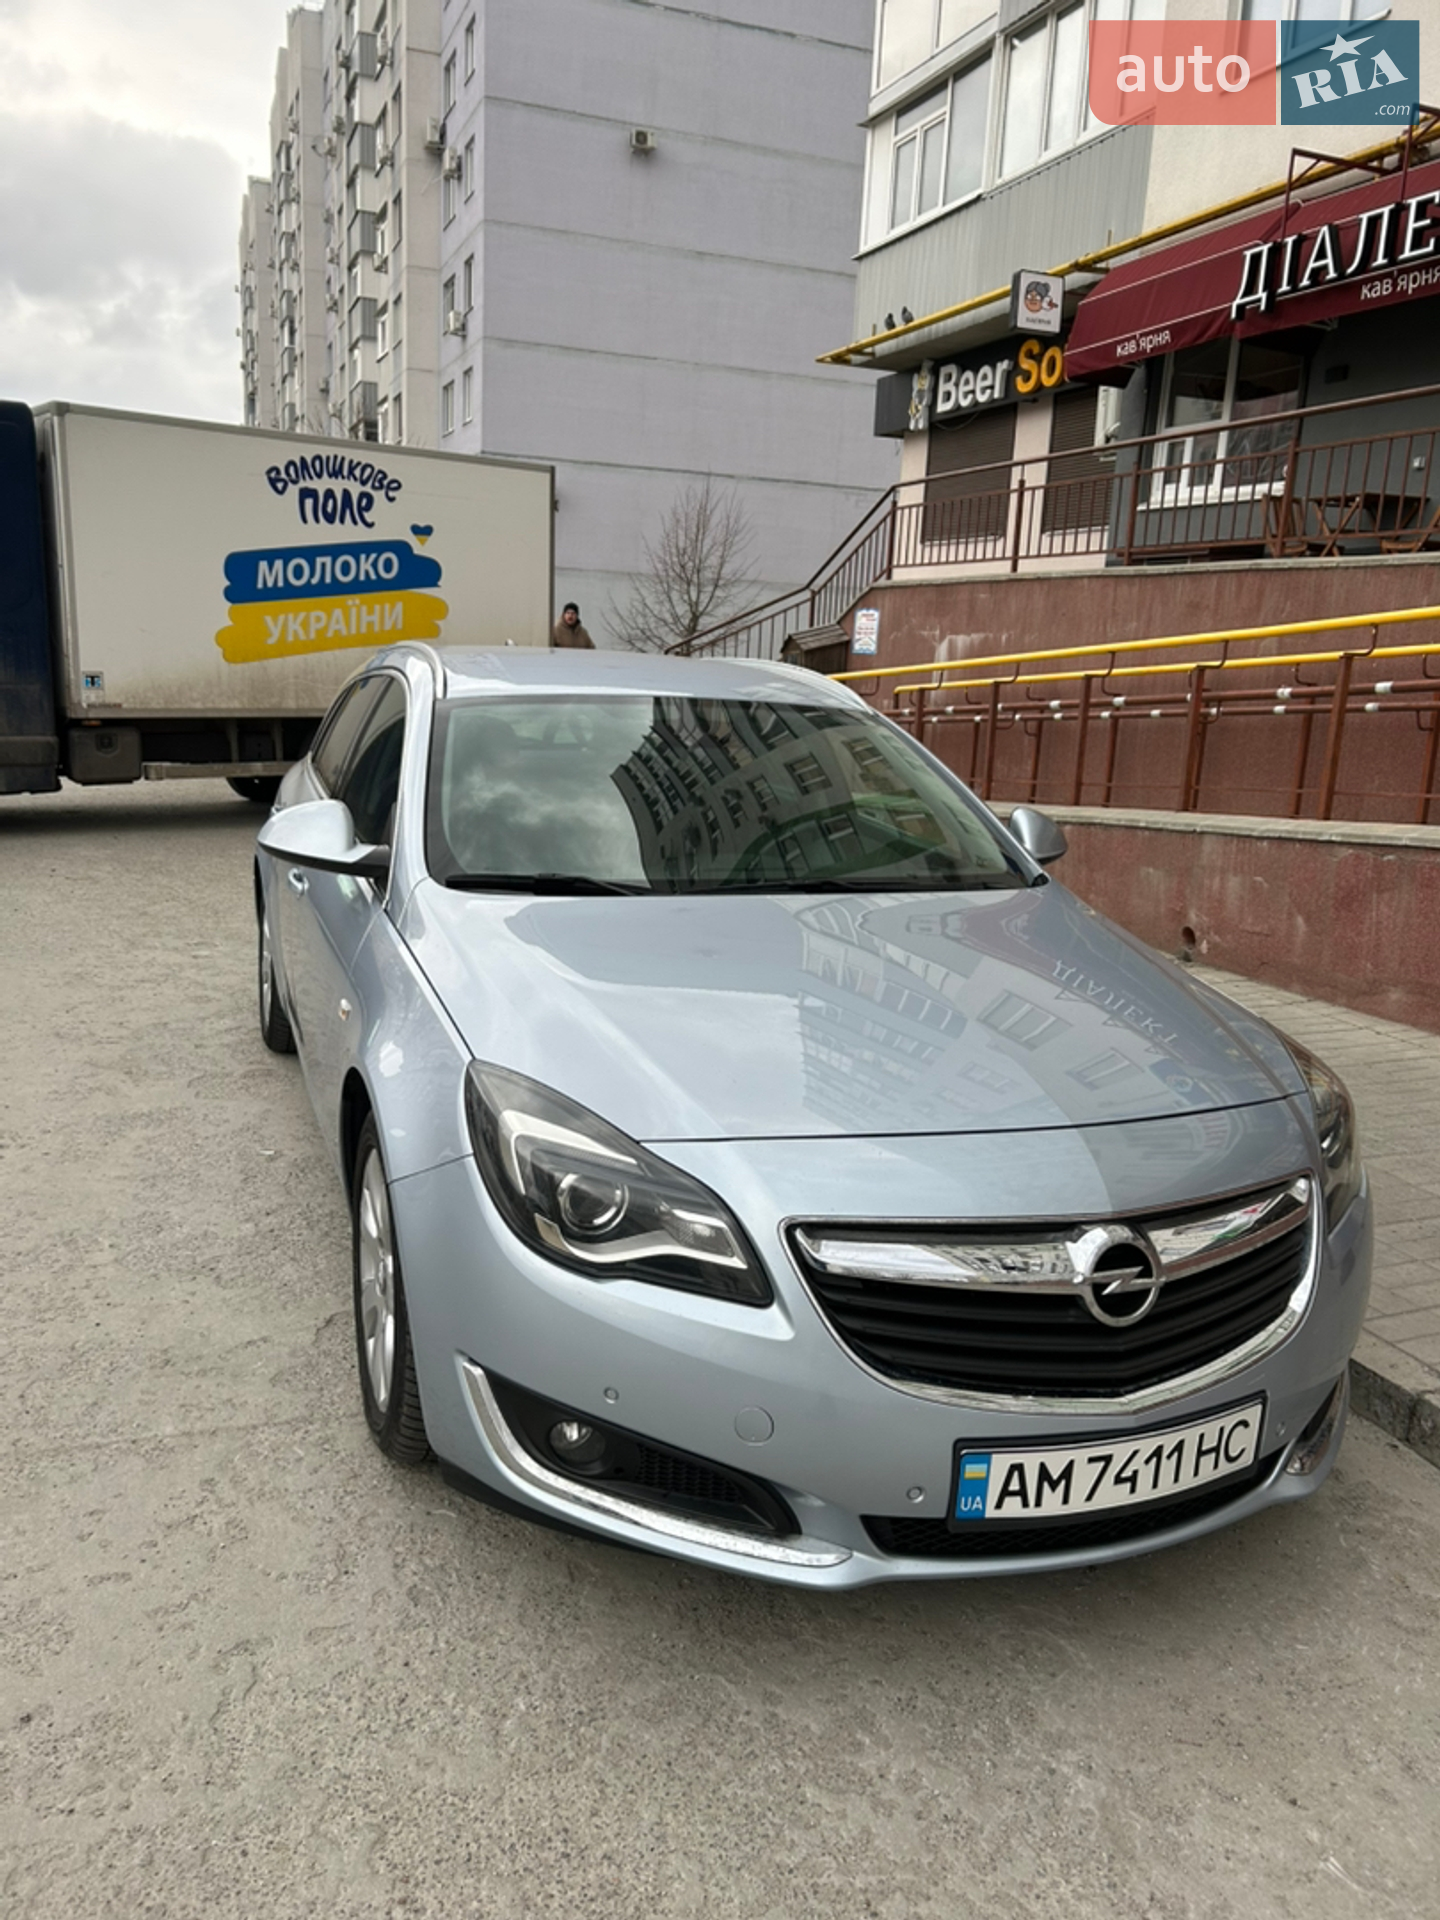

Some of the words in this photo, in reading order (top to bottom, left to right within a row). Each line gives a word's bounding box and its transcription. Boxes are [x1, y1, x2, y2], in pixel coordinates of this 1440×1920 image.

[936, 359, 1011, 414] Beer
[256, 551, 400, 589] МОЛОКО
[264, 598, 404, 645] УКРАЇНИ
[1083, 1437, 1186, 1503] 7411
[960, 1495, 984, 1512] UA
